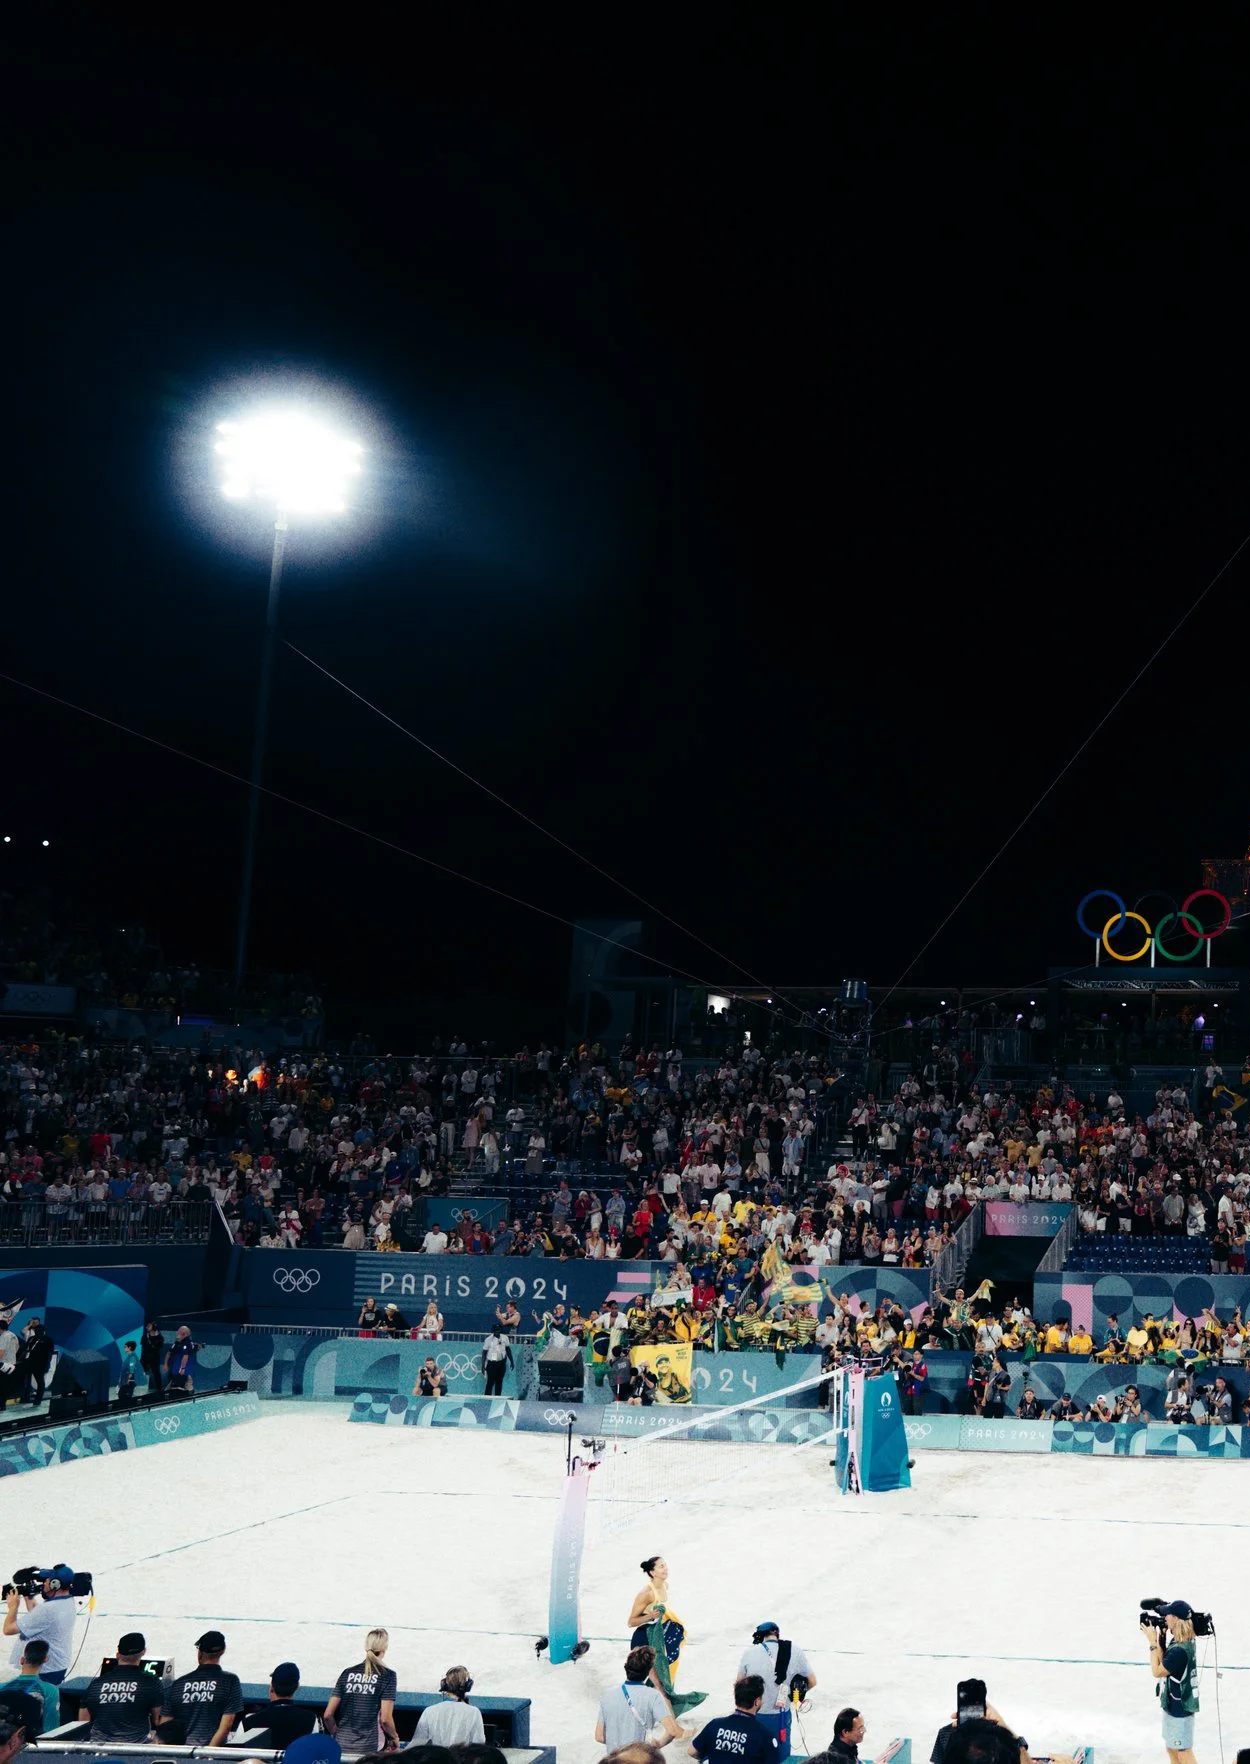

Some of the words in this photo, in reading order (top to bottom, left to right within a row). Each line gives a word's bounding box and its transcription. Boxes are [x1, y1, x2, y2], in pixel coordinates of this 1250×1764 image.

[380, 1272, 471, 1297] PARIS
[485, 1276, 567, 1301] 2024
[968, 1429, 1006, 1439] PARIS
[347, 1672, 379, 1684] PARIS
[101, 1681, 138, 1693] PARIS
[183, 1681, 217, 1692] PARIS
[345, 1682, 376, 1695] 2024
[99, 1692, 136, 1704] 2024
[182, 1692, 215, 1704] 2024
[716, 1727, 748, 1744] PARIS
[715, 1738, 745, 1755] 2024
